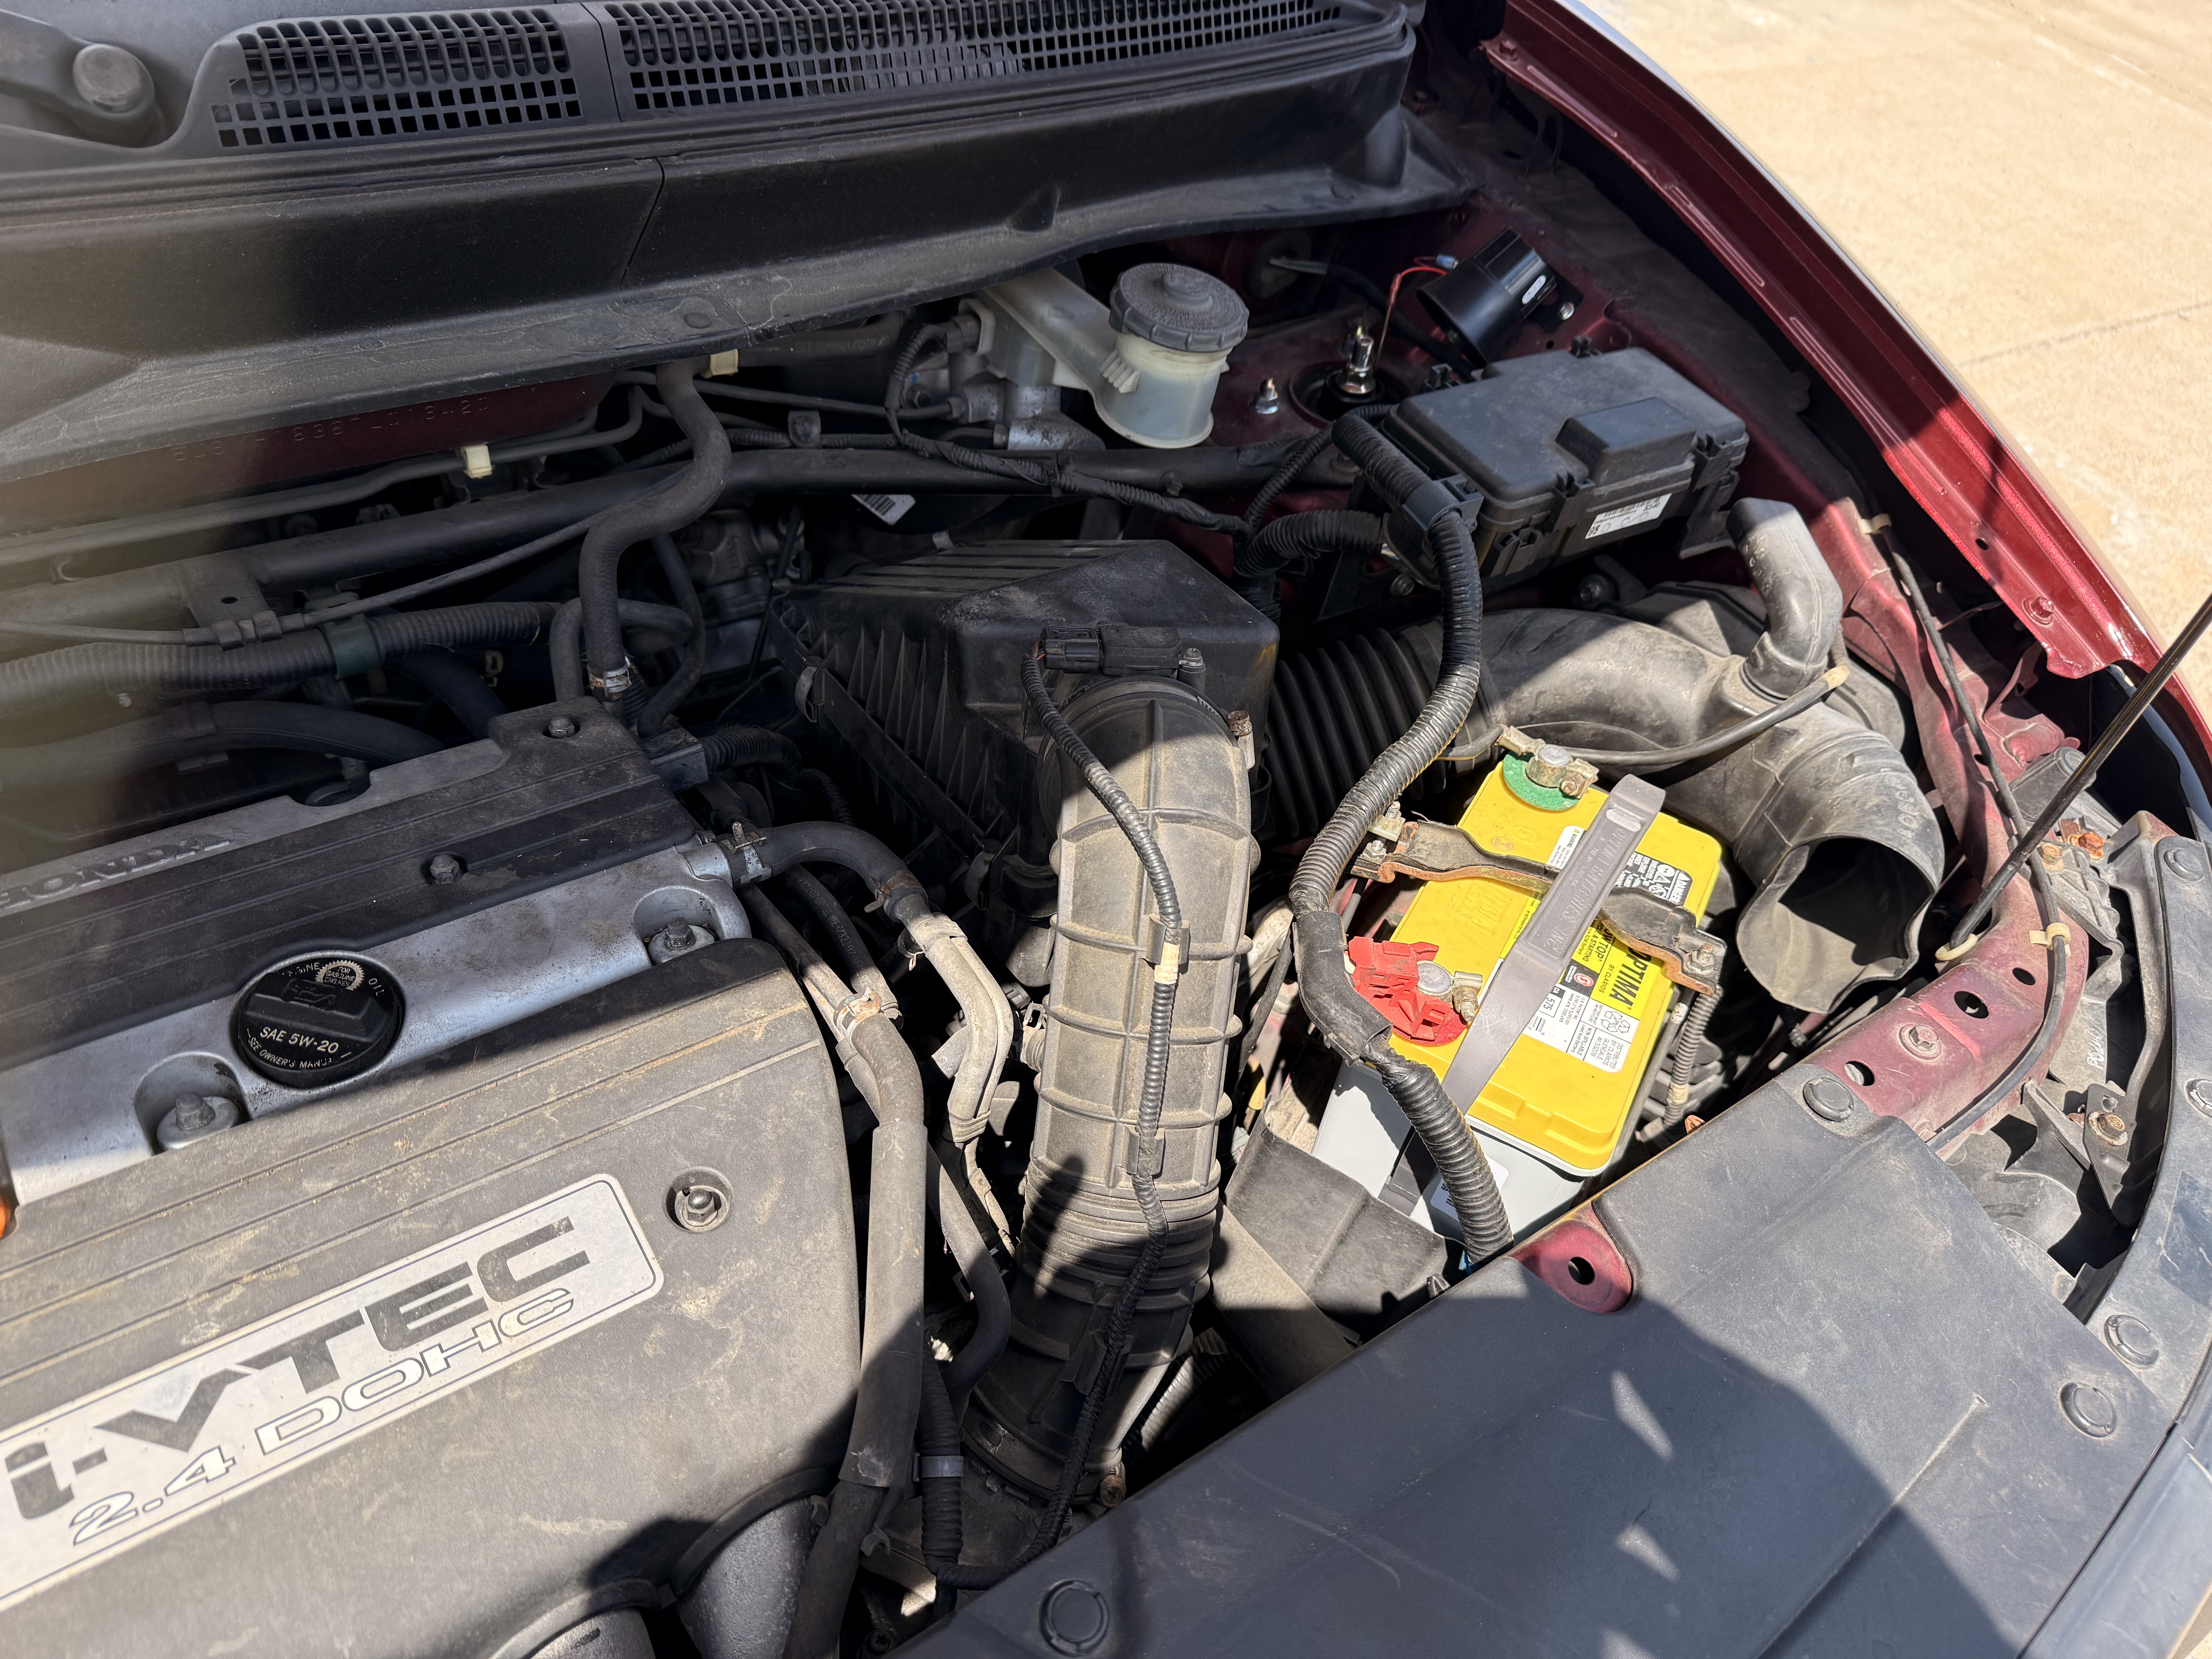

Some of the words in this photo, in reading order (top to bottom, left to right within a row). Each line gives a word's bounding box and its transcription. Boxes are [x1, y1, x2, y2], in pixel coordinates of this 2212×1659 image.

[1668, 878, 1688, 904] DANGER
[826, 913, 840, 927] HOSE
[1582, 938, 1597, 963] STARTING
[282, 963, 320, 977] GINE
[369, 978, 385, 996] OIL
[326, 971, 356, 982] GASOLINE
[1607, 964, 1614, 972] BY
[858, 974, 872, 988] HOSE
[1598, 971, 1611, 993] CLARIOS
[1542, 996, 1554, 1011] 575
[260, 1027, 287, 1042] SAE
[288, 1033, 339, 1054] 5W-20
[1570, 1039, 1580, 1053] Battery
[1577, 1027, 1593, 1056] NON-SPILLABLE
[1590, 1042, 1601, 1057] 53209
[248, 1037, 262, 1052] SEE
[259, 1049, 296, 1067] OWNER'S
[299, 1058, 332, 1068] MANU
[1602, 1046, 1614, 1066] CLARIOS
[1608, 1042, 1624, 1069] DISTRIBUTED
[5, 1216, 591, 1521] i-VTEC
[69, 1444, 237, 1547] 2.4
[255, 1288, 575, 1457] DOHC
